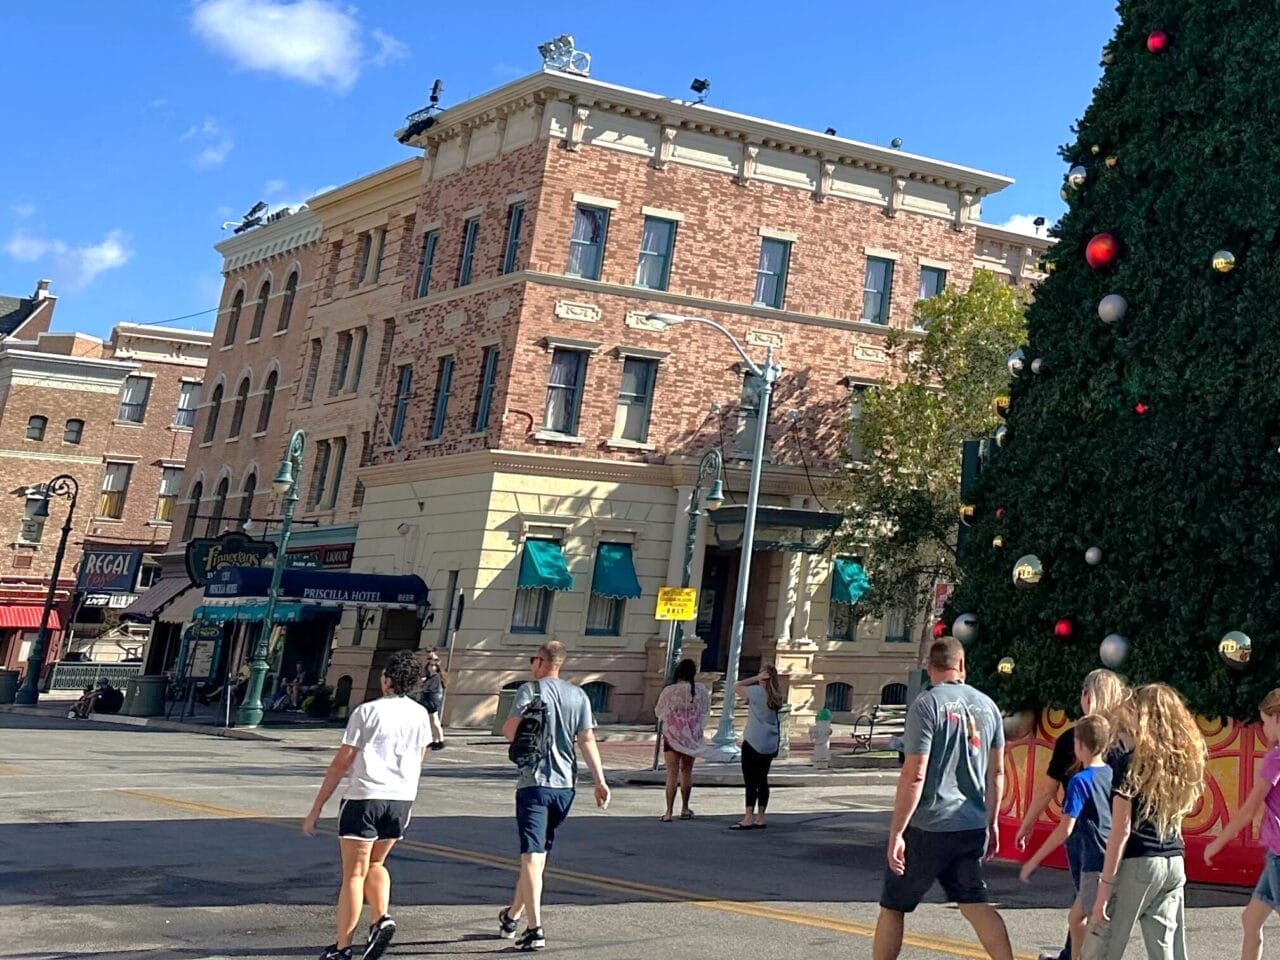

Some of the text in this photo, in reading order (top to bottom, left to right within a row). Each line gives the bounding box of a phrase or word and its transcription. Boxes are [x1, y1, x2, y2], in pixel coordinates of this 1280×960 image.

[326, 550, 349, 563] LIQUOR
[85, 553, 131, 575] REGAL
[303, 588, 349, 600] PRISCILLA
[351, 591, 381, 602] HOTEL
[397, 593, 415, 602] BEER
